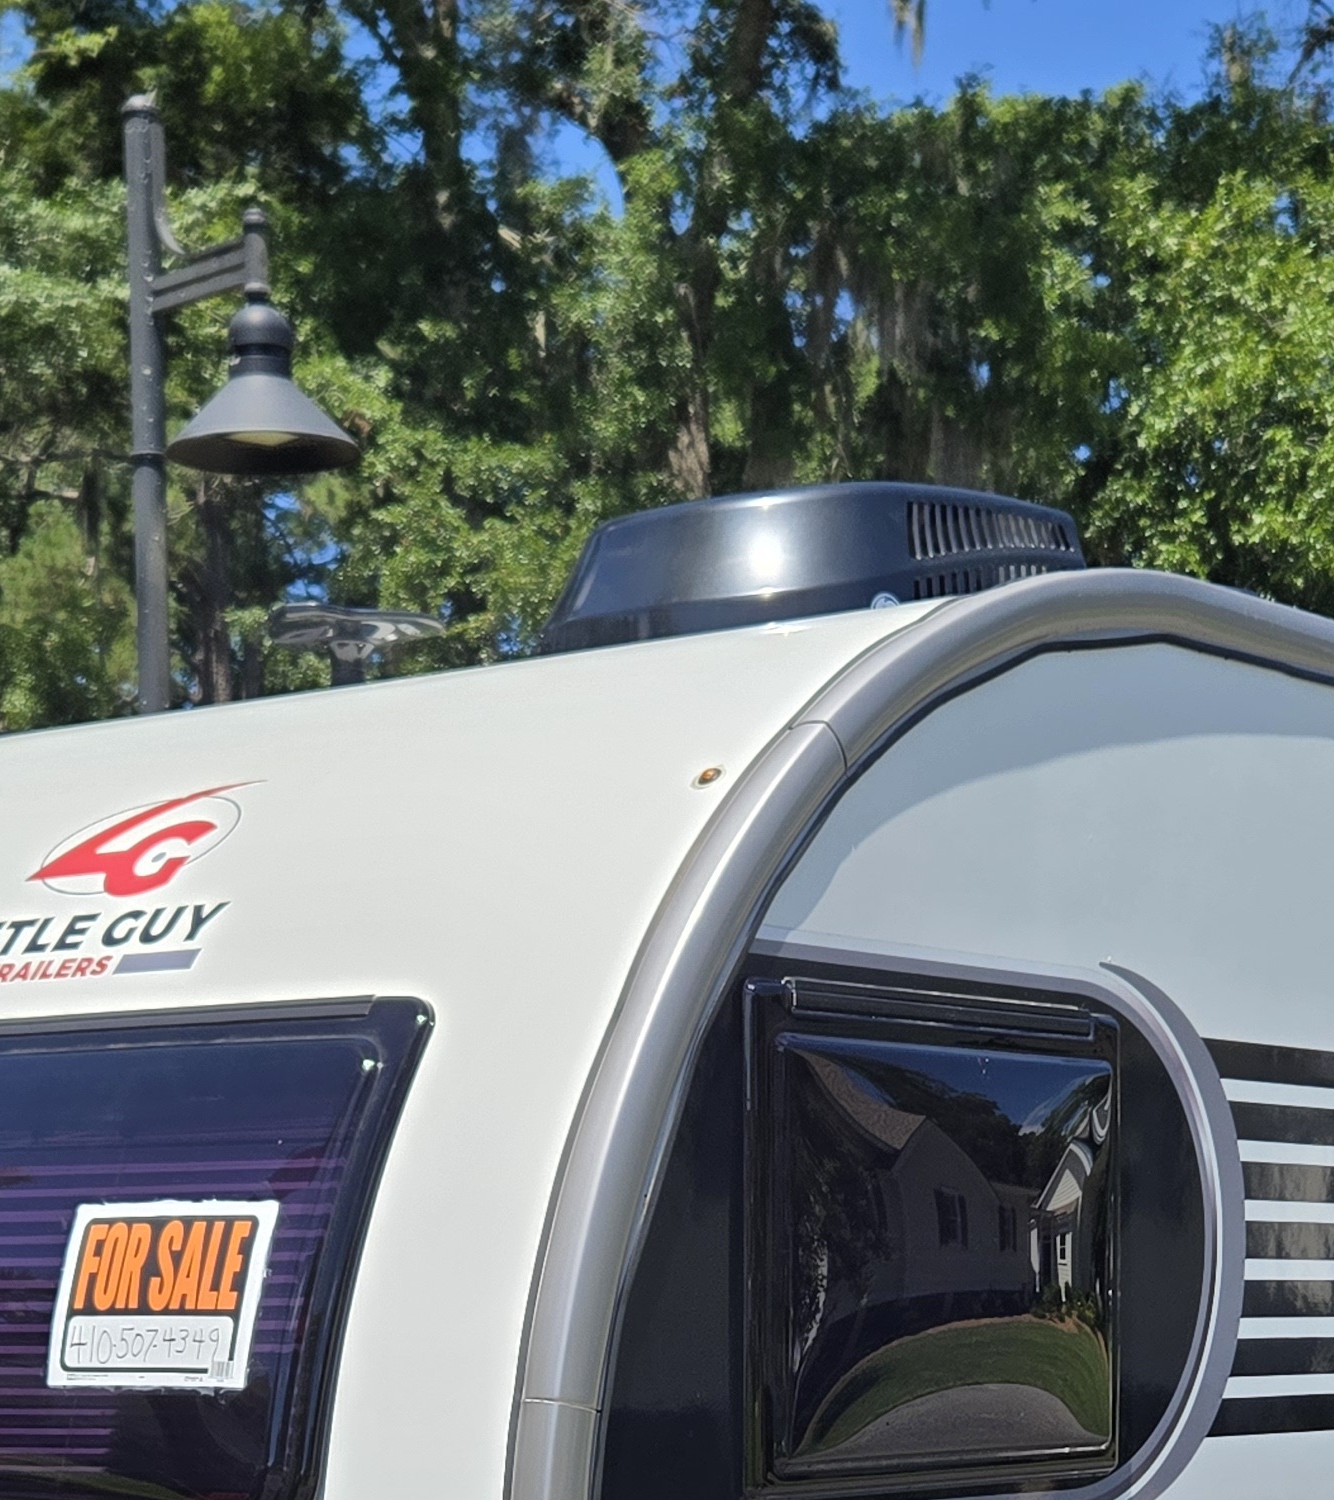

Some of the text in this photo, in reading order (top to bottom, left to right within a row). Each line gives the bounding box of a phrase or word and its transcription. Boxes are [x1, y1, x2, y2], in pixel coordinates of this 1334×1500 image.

[100, 900, 232, 948] GUY
[72, 1219, 253, 1312] FOR SALE
